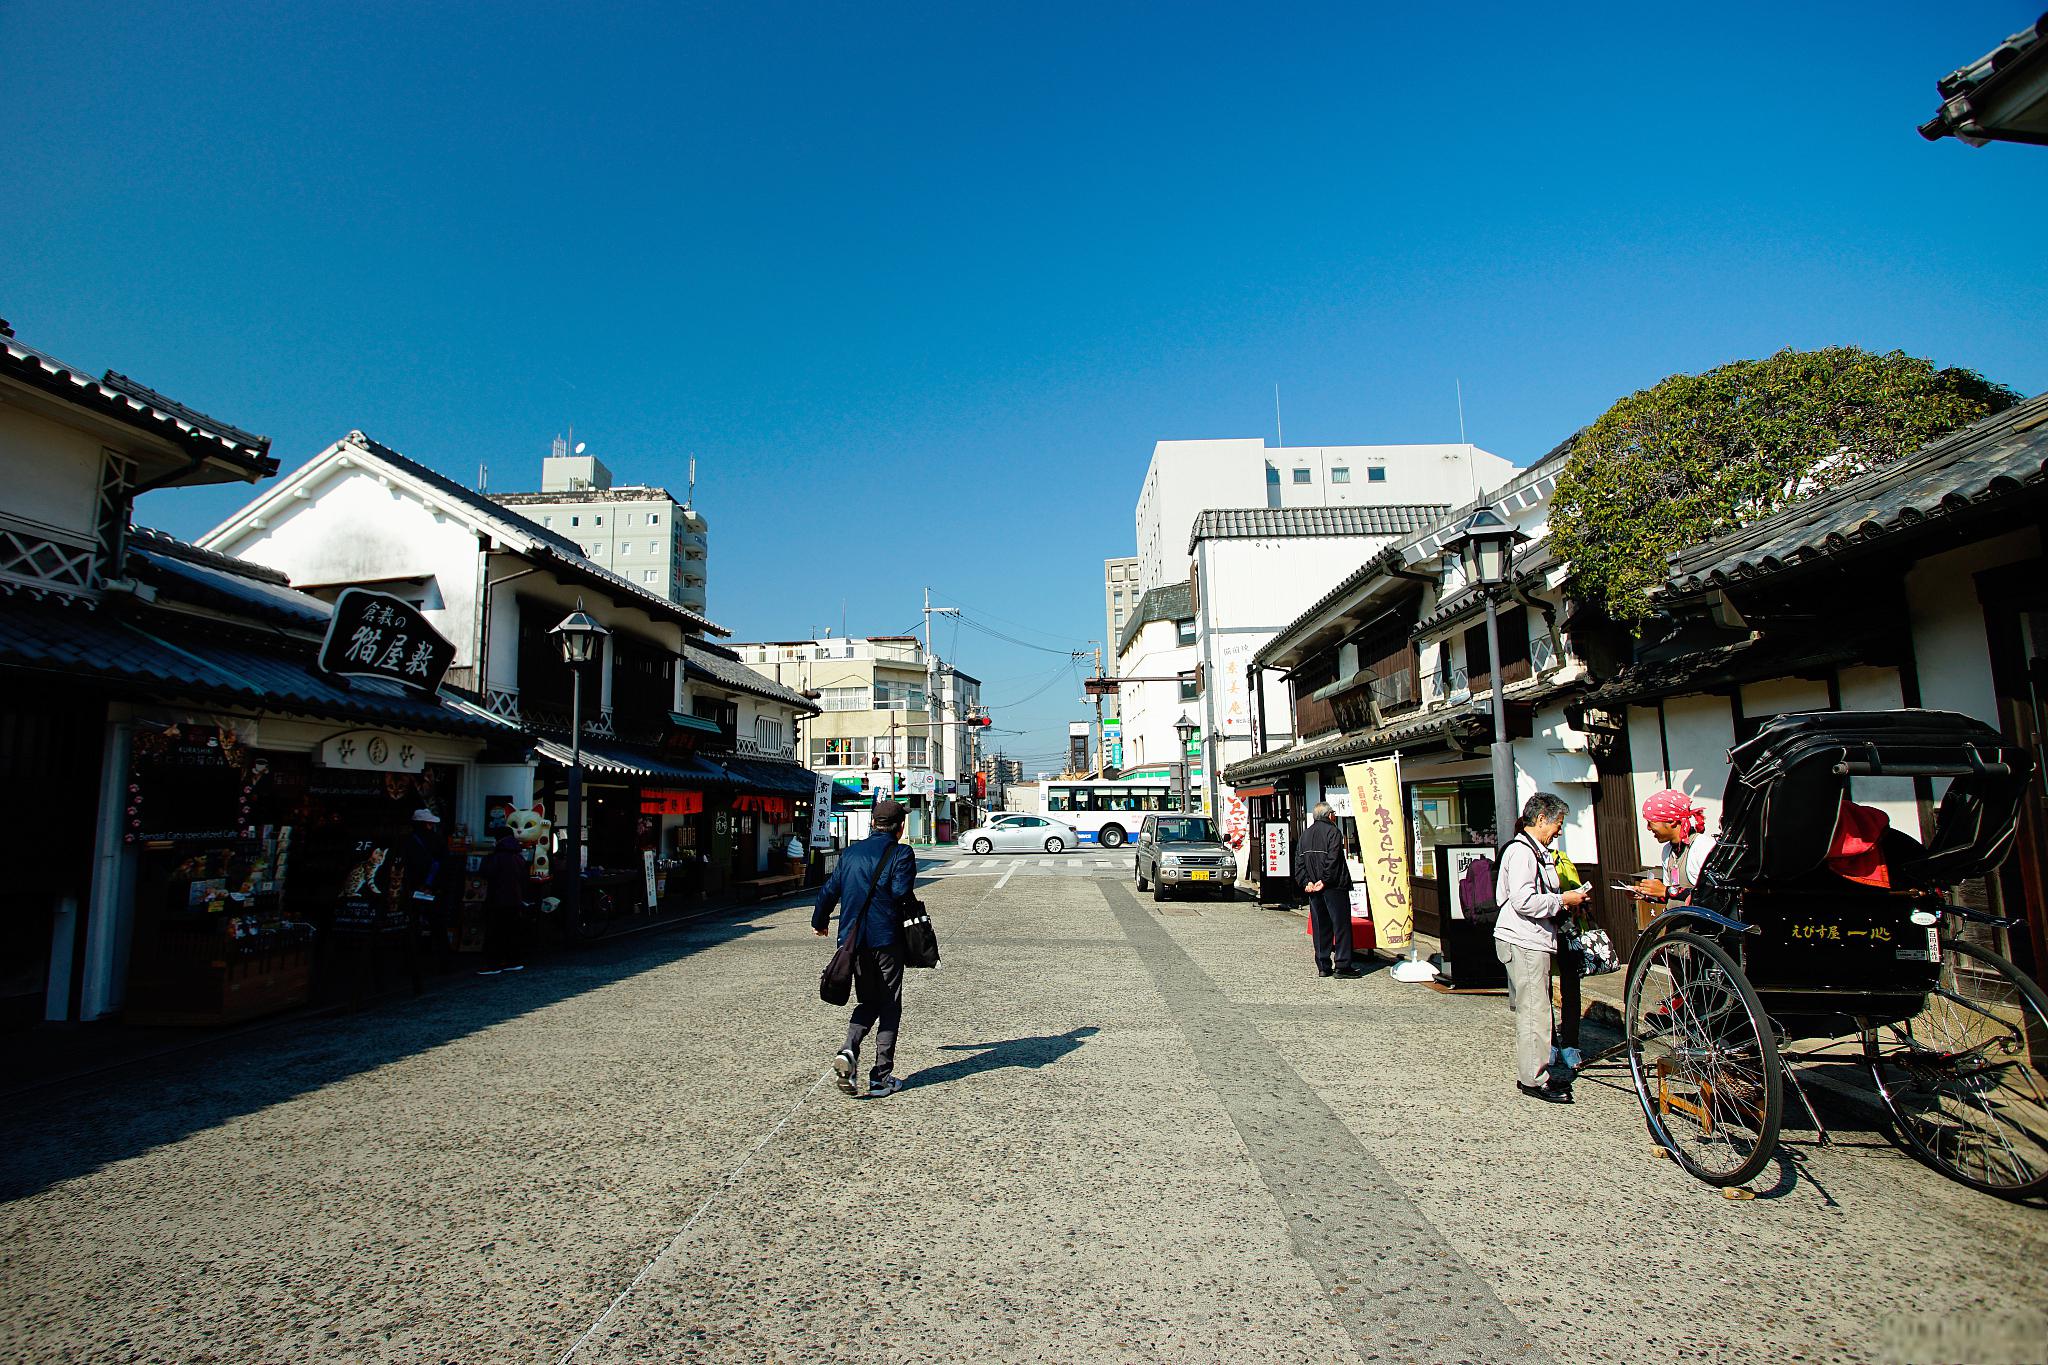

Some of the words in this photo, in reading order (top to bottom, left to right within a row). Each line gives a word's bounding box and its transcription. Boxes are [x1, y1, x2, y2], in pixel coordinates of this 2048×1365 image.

[361, 600, 407, 629] 倉敷の
[345, 625, 434, 677] 猫屋敷
[944, 780, 956, 793] P
[355, 840, 374, 851] 2F
[1269, 832, 1278, 872] 手作り体験工房
[1791, 924, 1842, 940] えびす屋
